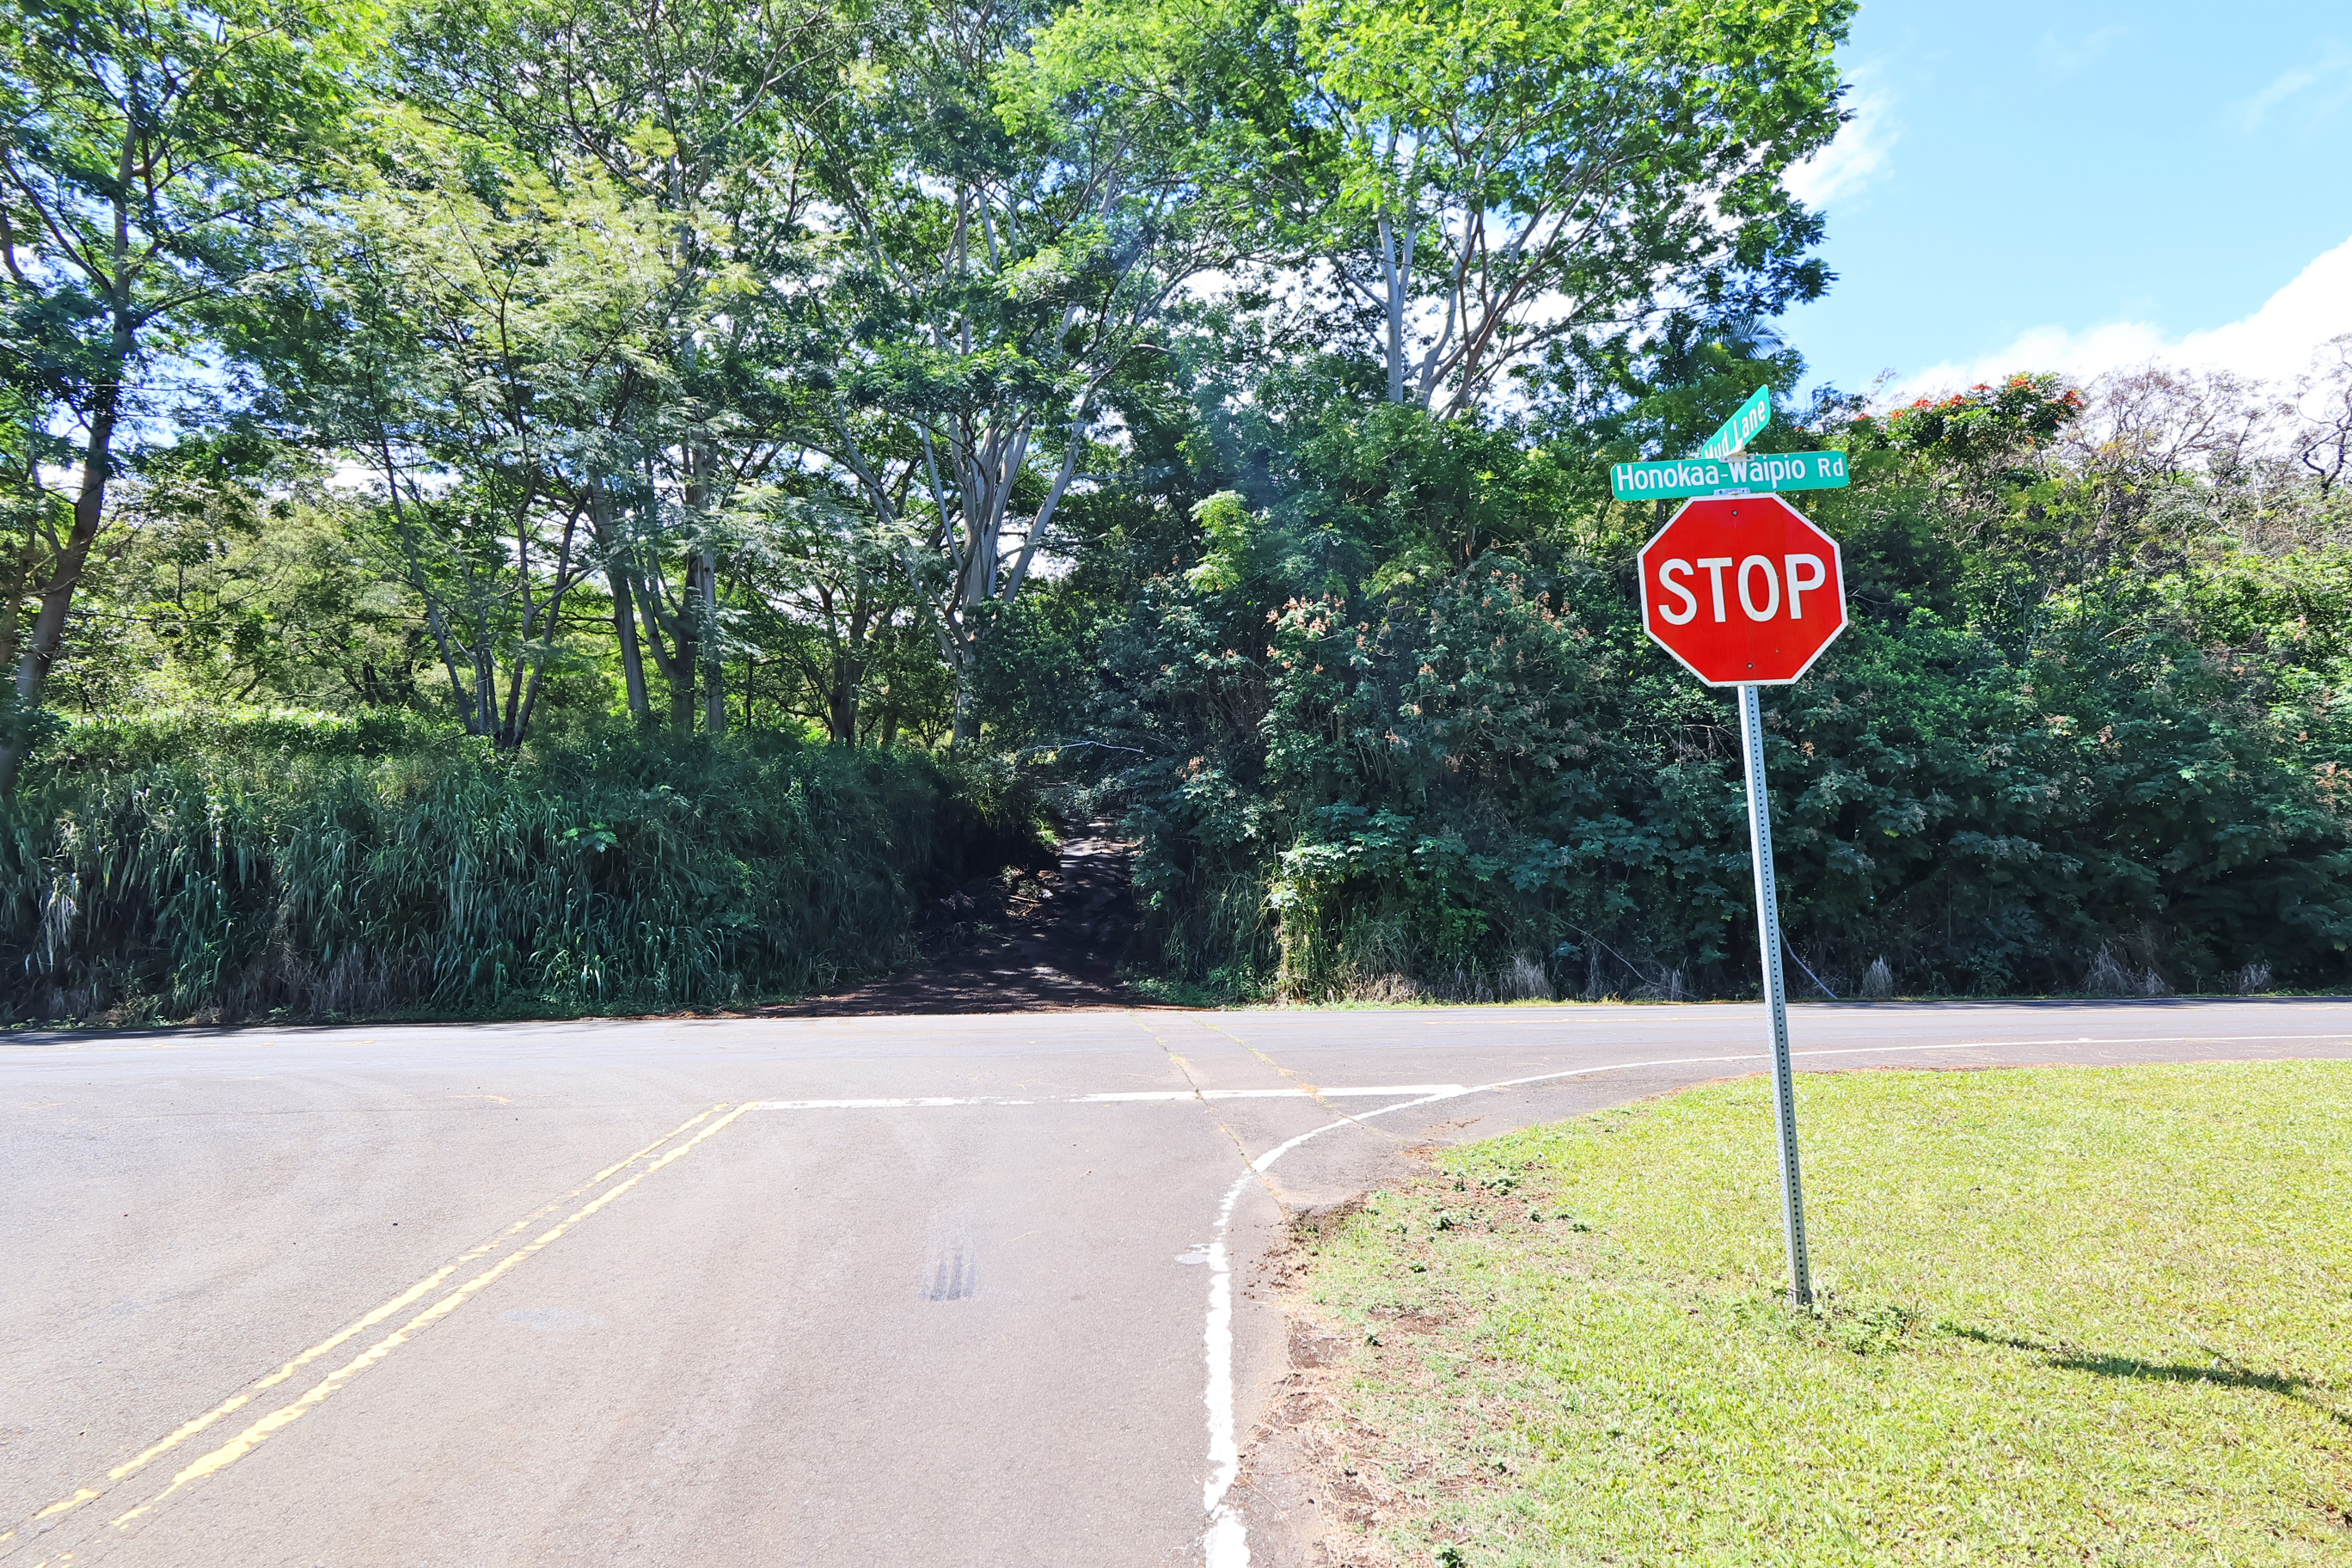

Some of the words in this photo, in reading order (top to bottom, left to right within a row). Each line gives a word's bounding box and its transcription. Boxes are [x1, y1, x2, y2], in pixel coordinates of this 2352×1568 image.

[1733, 401, 1766, 446] Lane
[1616, 455, 1806, 491] Honokaa-Waipio
[1817, 457, 1844, 478] Rd
[1658, 553, 1826, 626] STOP
